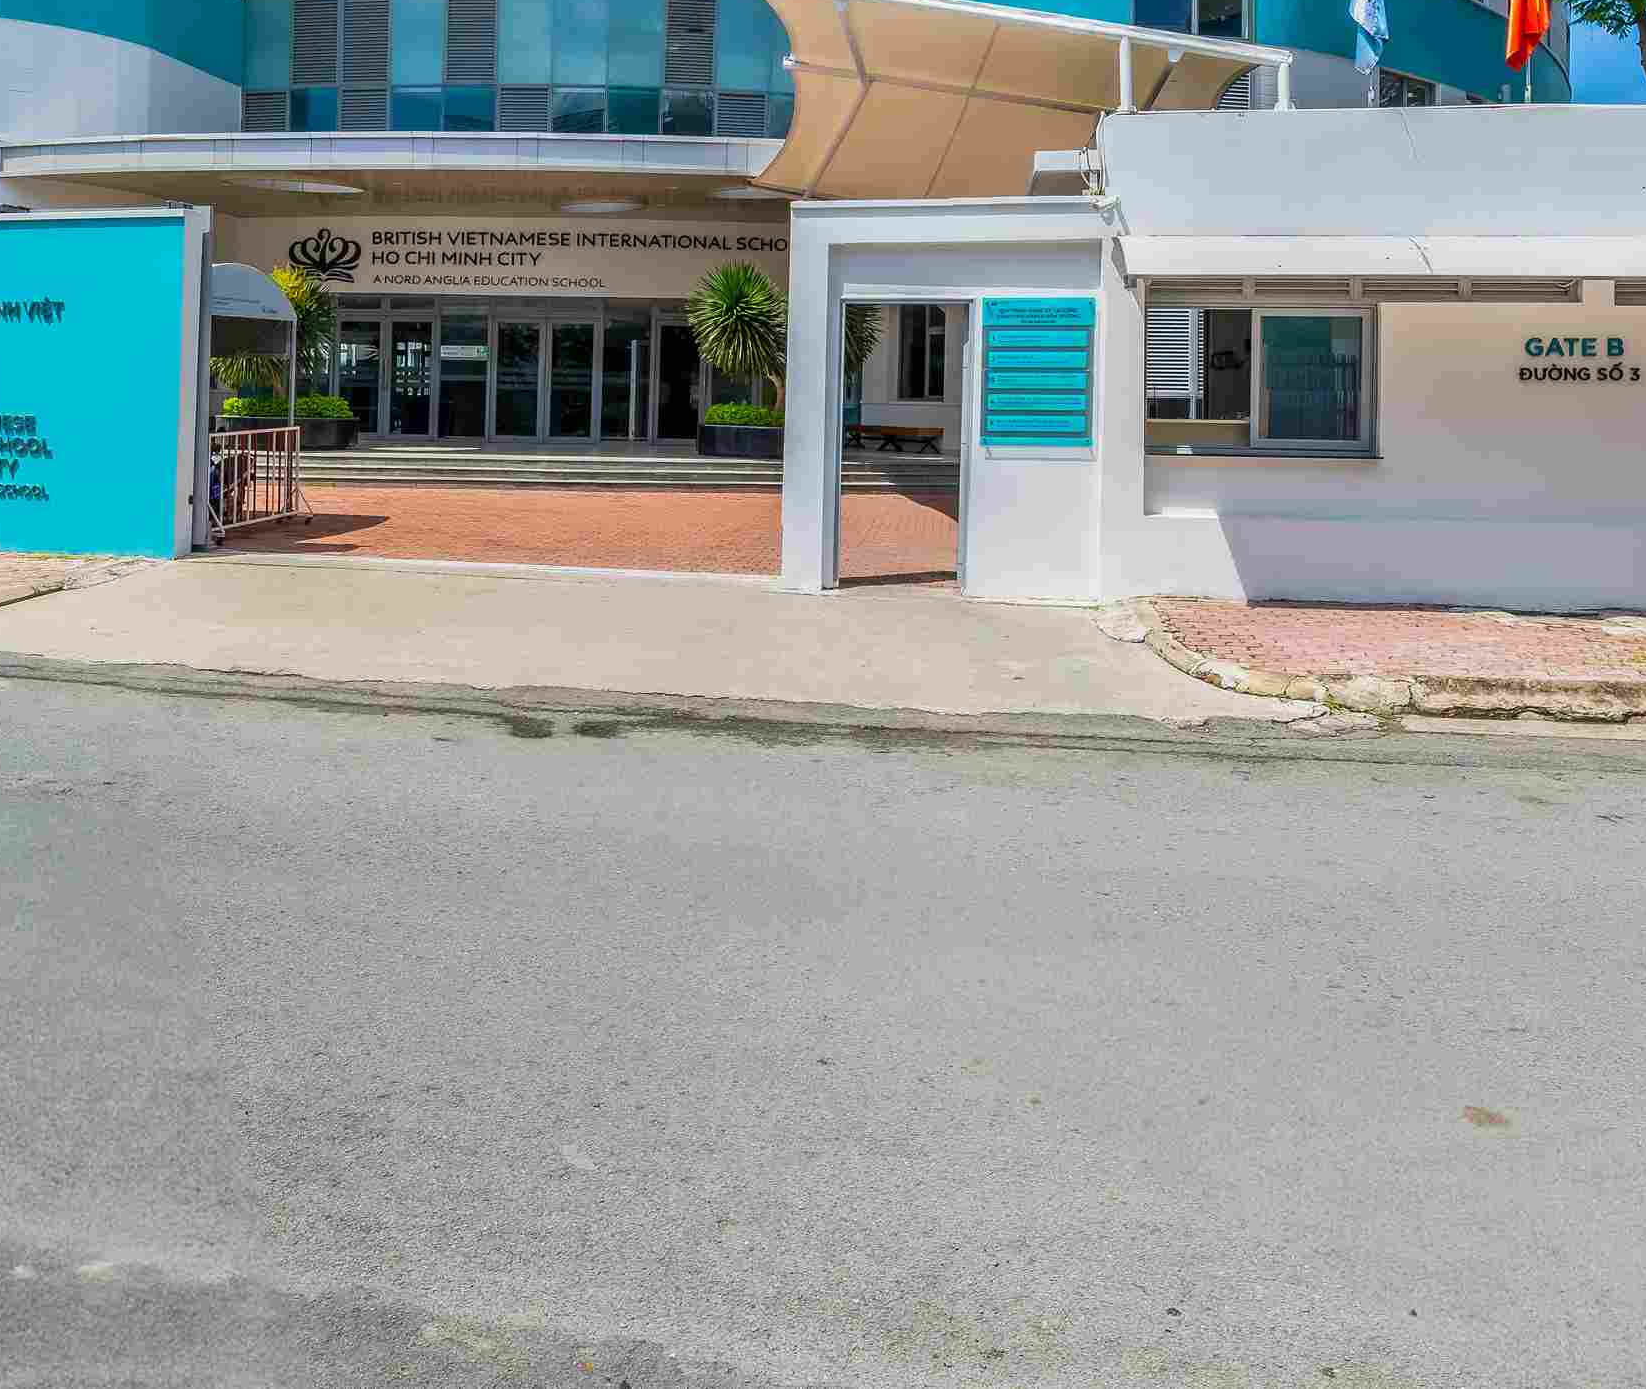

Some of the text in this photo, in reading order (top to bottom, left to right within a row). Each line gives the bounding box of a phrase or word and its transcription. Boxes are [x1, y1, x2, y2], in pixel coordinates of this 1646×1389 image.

[371, 231, 787, 252] BRITISH VIETNAMESE INTERNATIONAL SCHO
[371, 251, 542, 267] HO CHI MINH CITY
[373, 274, 606, 288] A NORD ANGLIA EDUCATION SCHOOL
[1524, 337, 1625, 357] GATE B
[1519, 362, 1641, 381] ĐƯỜNG SỐ 3
